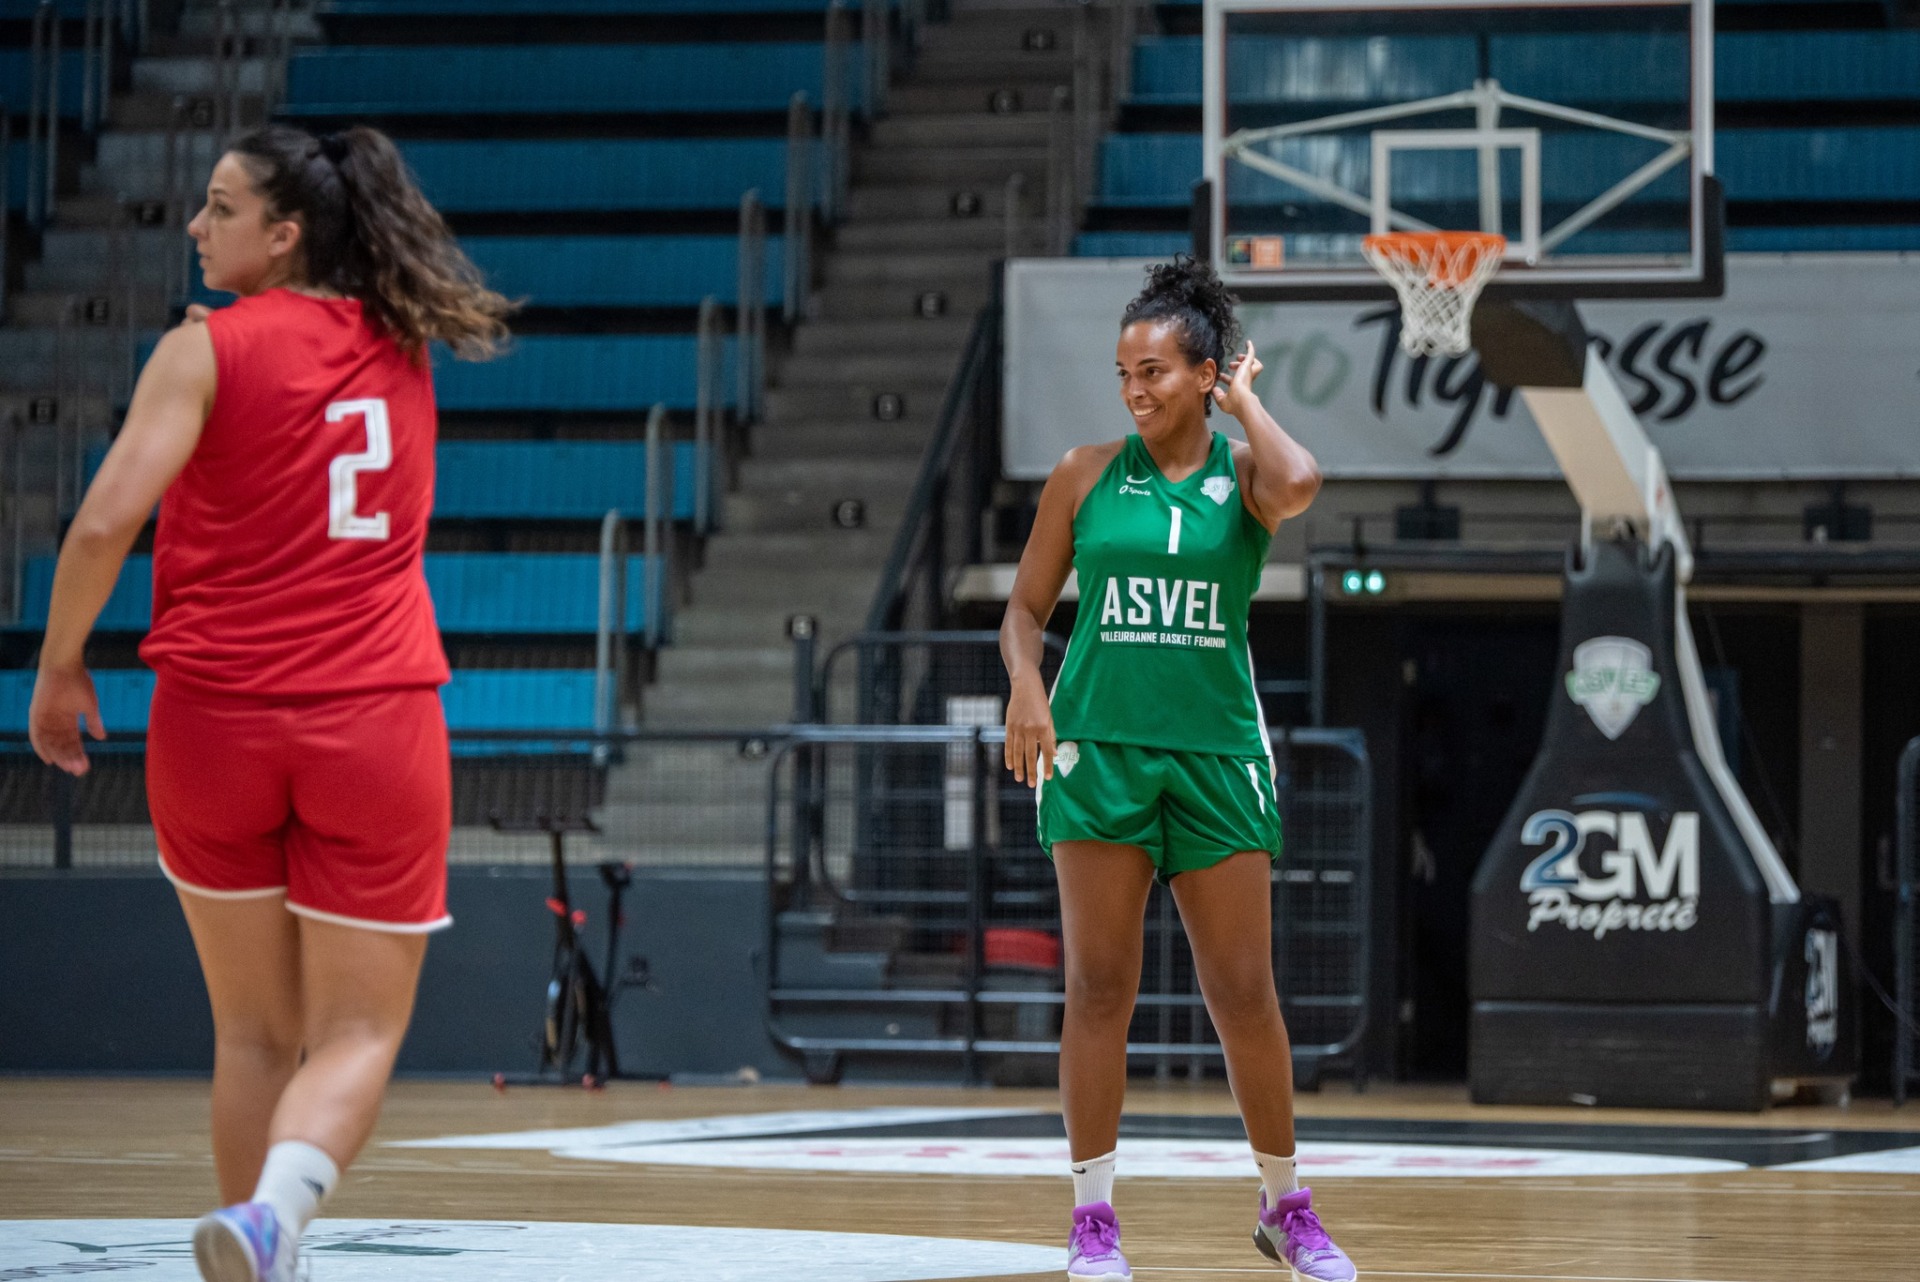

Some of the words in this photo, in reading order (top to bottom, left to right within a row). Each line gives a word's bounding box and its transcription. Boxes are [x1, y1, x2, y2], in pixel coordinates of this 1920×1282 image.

[1354, 308, 1766, 456] Tigsse
[325, 398, 392, 540] 2
[1167, 505, 1182, 554] 1
[1100, 576, 1226, 632] ASVEL
[1100, 631, 1157, 643] VILLEURBANNE
[1160, 632, 1192, 646] BASKET
[1194, 635, 1226, 648] FEMININ
[1520, 808, 1699, 901] 2GM
